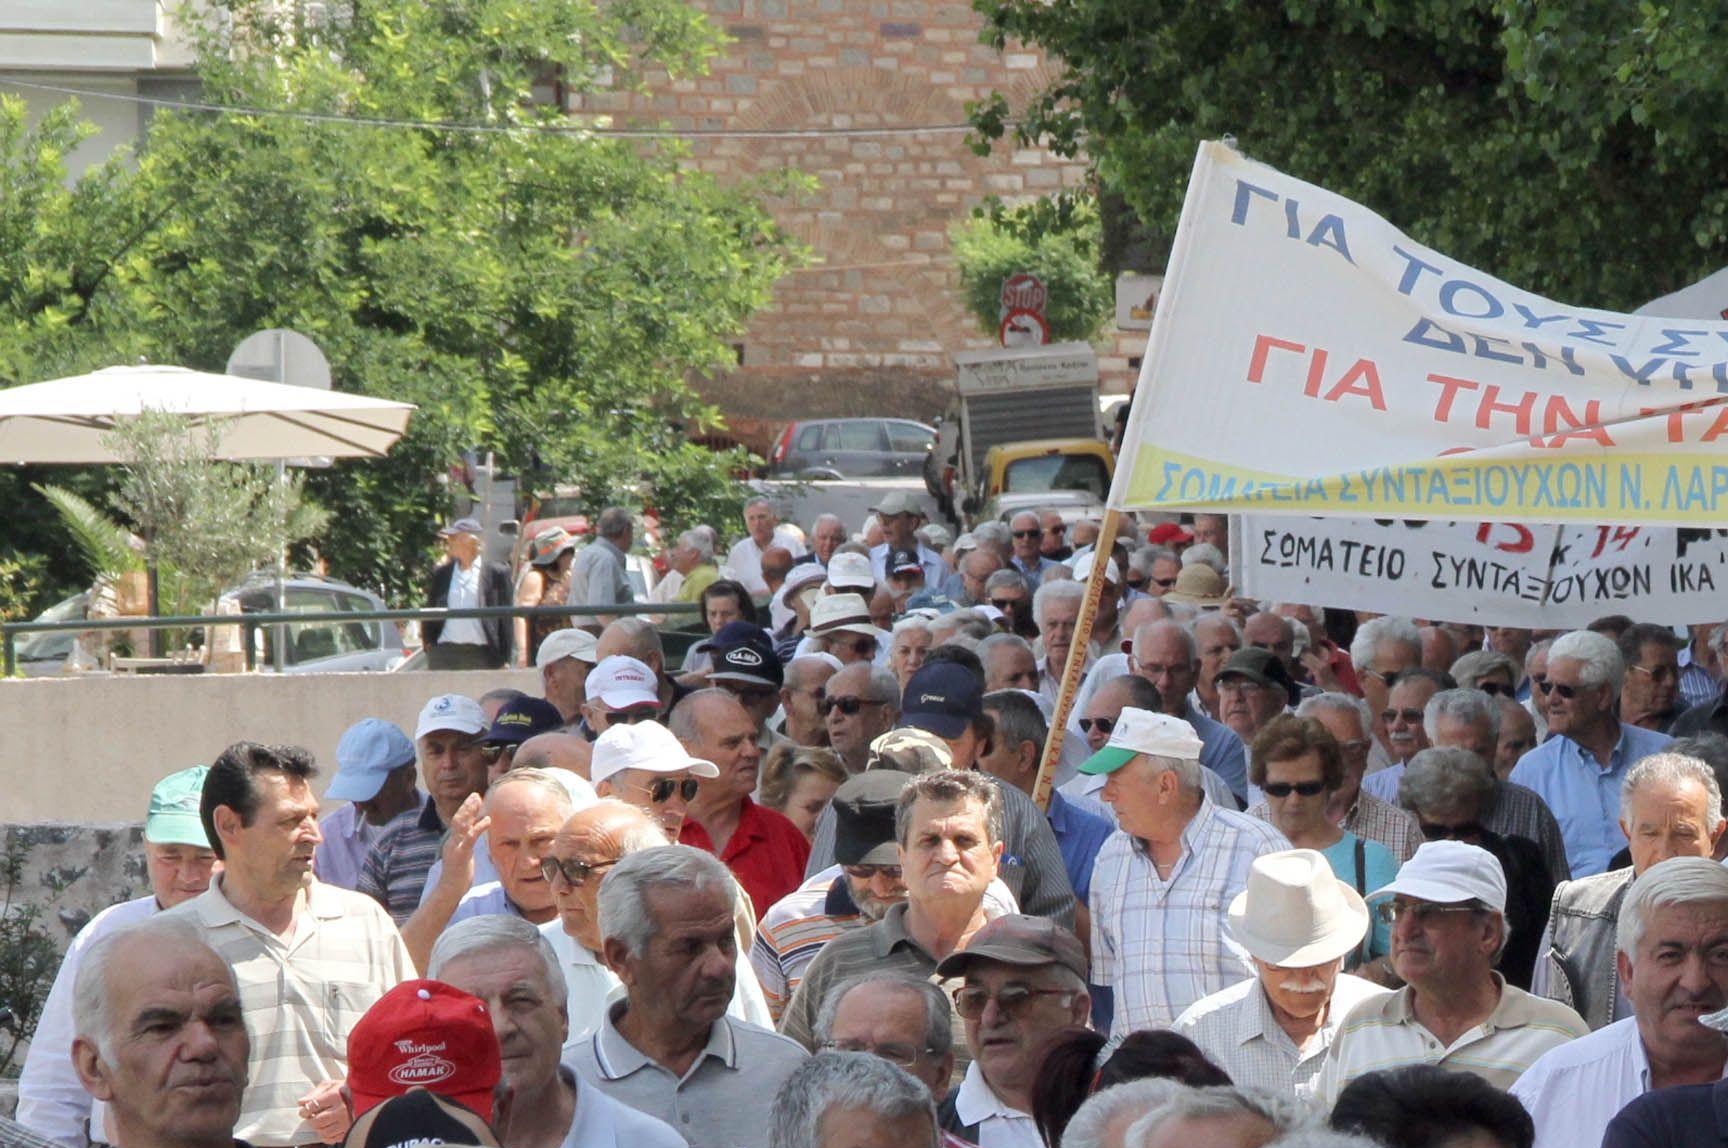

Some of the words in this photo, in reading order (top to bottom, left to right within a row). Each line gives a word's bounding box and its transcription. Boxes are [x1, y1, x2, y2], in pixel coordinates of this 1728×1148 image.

[1229, 178, 1358, 266] ΓΙΑ
[1390, 245, 1625, 348] ΤΟΥΣ
[1402, 315, 1586, 376] ΔΕΝ
[1246, 334, 1387, 411] ΓΙΑ
[1426, 373, 1601, 436] ΤΗΝ
[1338, 462, 1607, 509] ΣΥΝΤΑΞΙΟΥΧΩΝ
[1619, 465, 1651, 510] Ν.
[1259, 529, 1405, 581] ΣΩΜΑΤΕΙΟ
[1431, 550, 1652, 605] ΣΥΝΤΑΞΙΟΥΧΩΝ
[394, 1040, 446, 1053] Whirlpool
